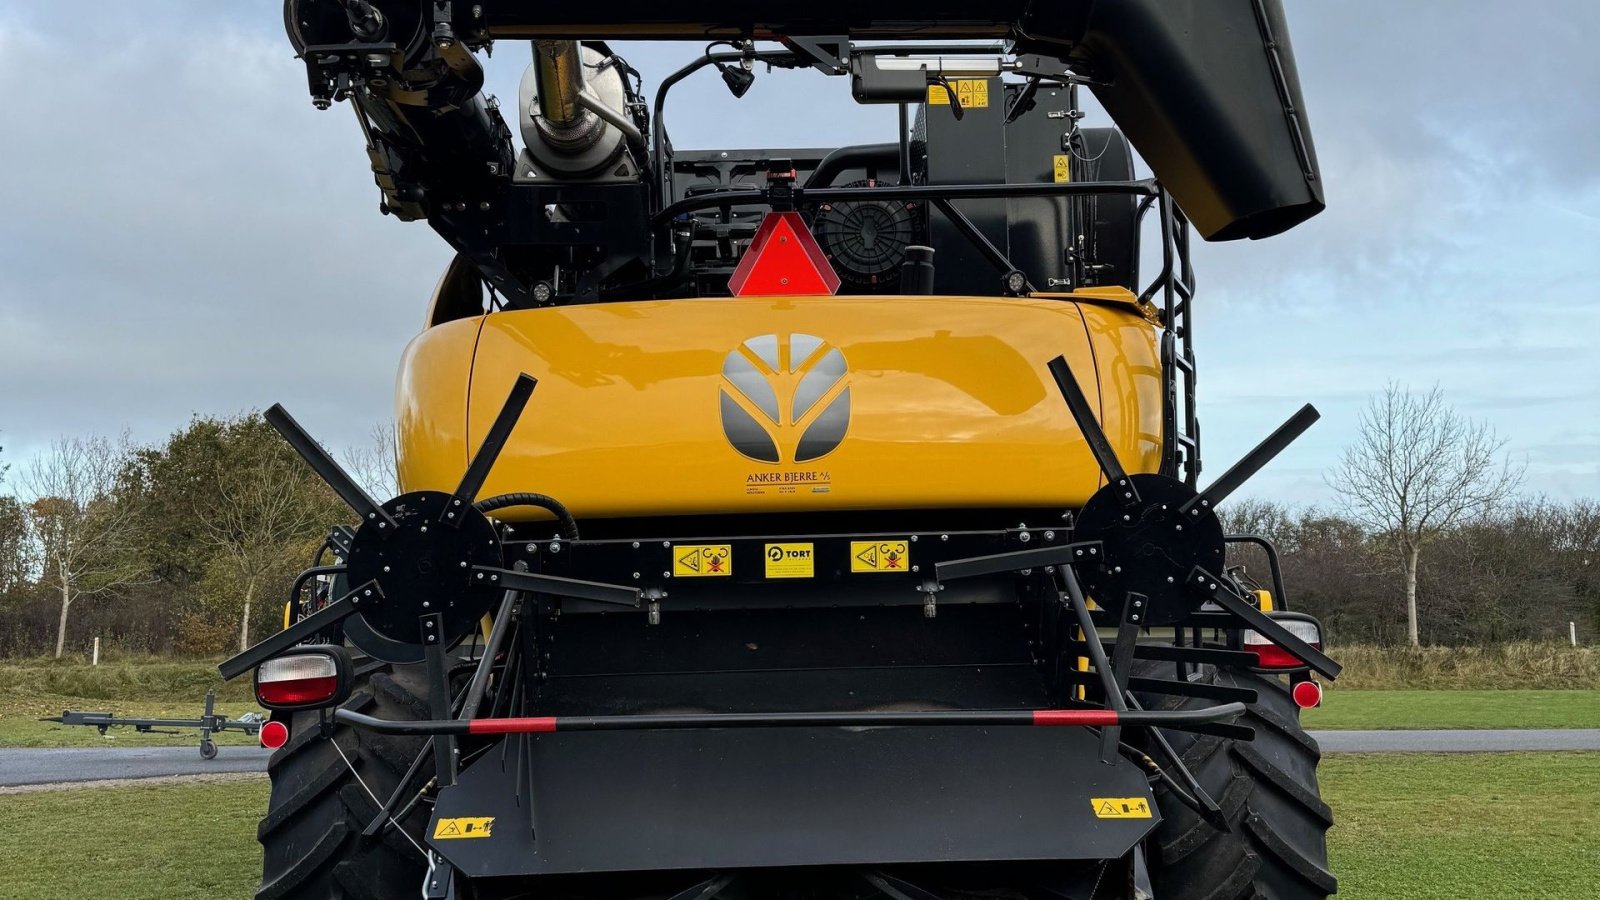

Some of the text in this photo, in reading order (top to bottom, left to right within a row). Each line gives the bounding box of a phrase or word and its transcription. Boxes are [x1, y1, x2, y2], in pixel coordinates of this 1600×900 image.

[747, 472, 782, 482] ANKER
[784, 471, 818, 483] BJERRE
[785, 550, 811, 558] TORT
